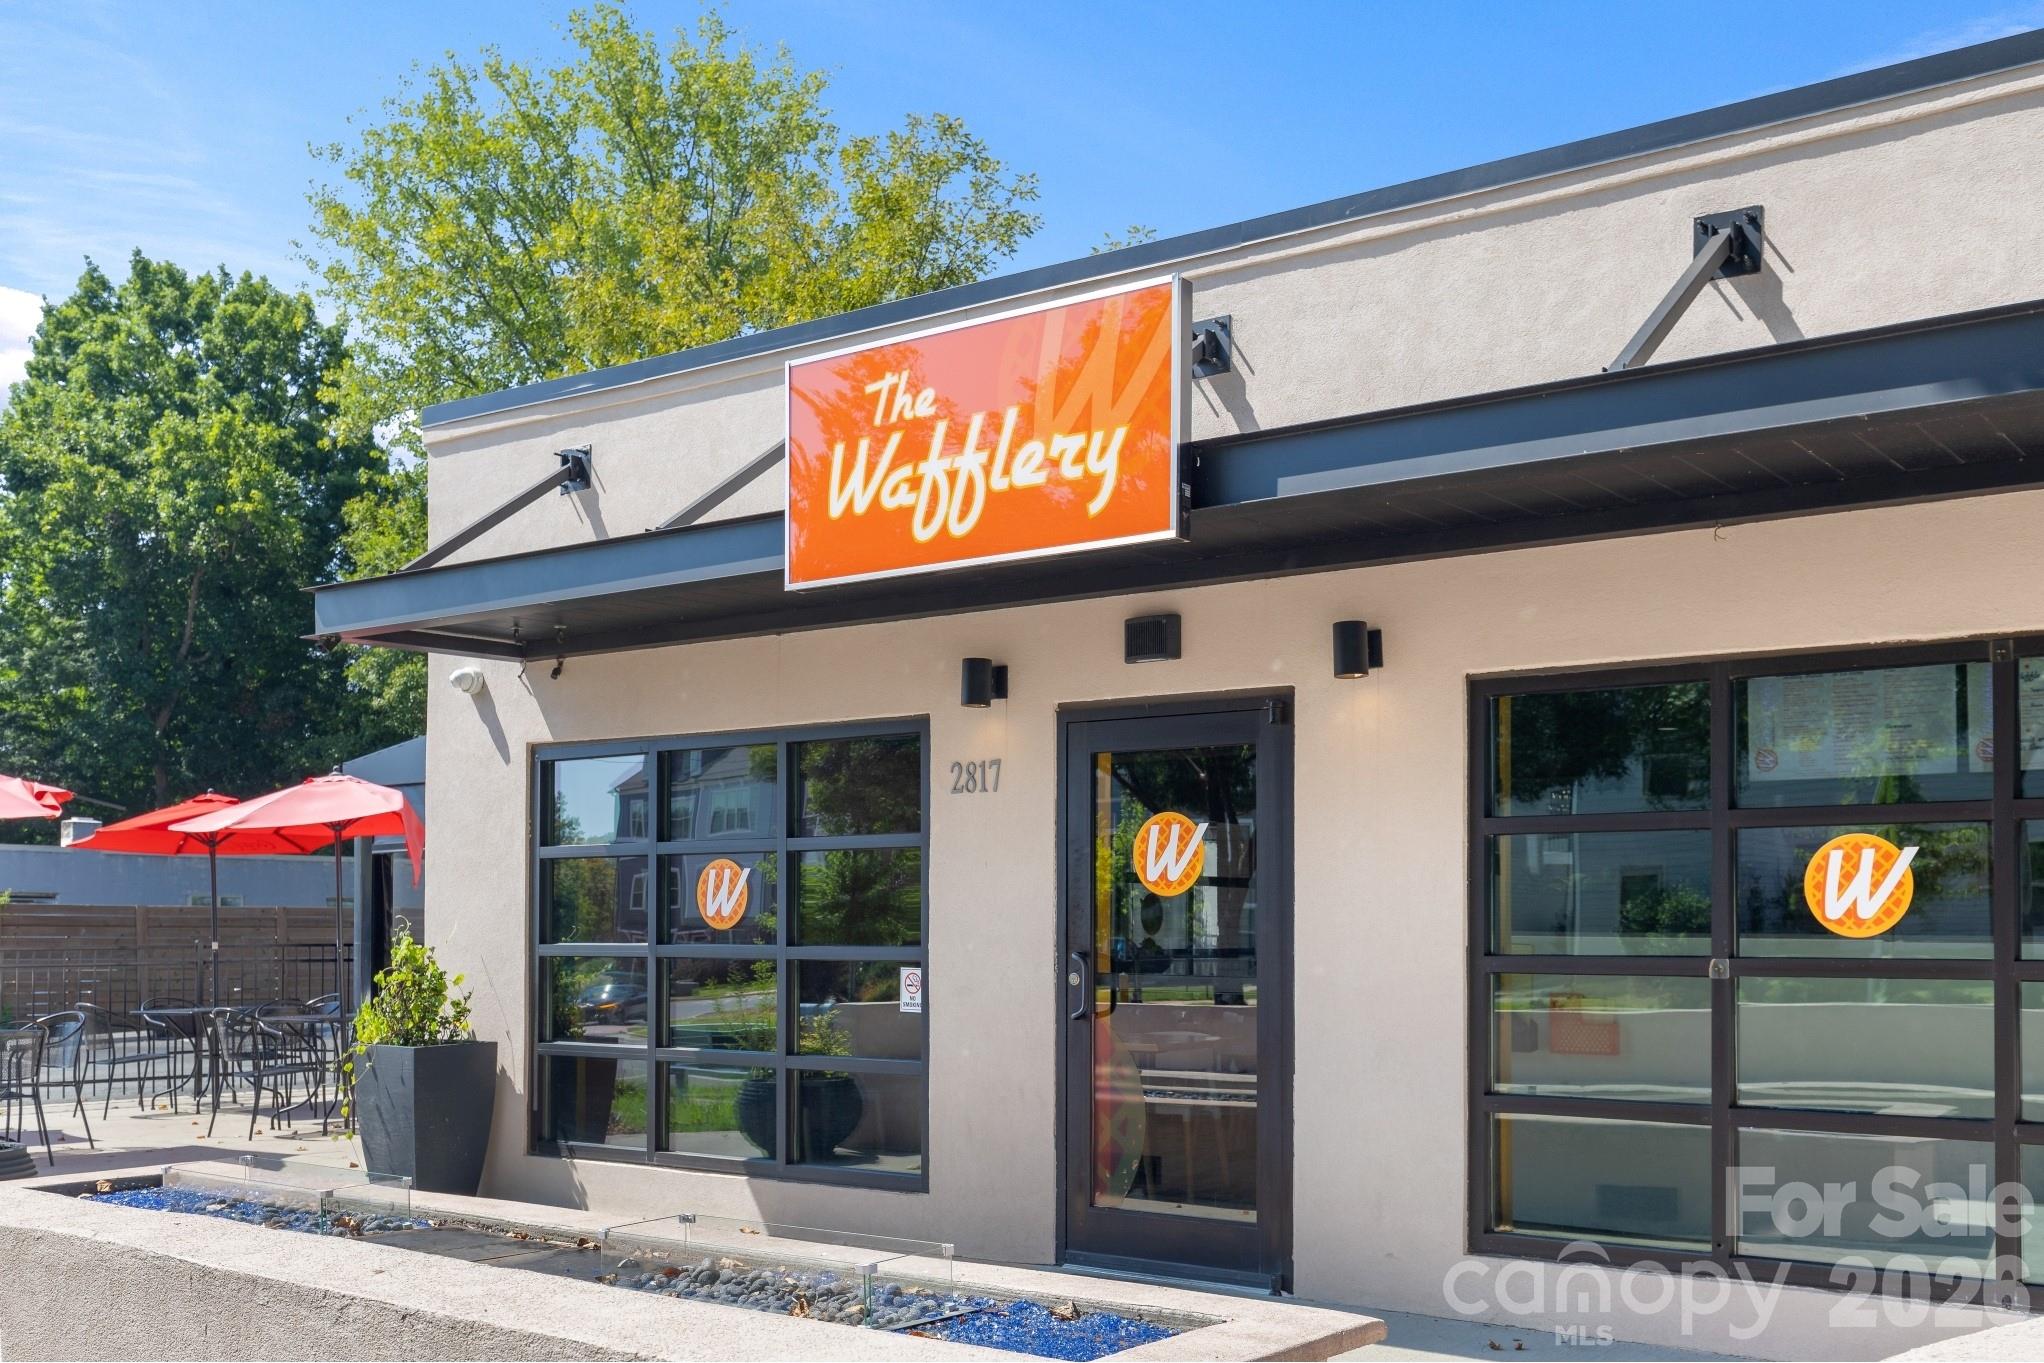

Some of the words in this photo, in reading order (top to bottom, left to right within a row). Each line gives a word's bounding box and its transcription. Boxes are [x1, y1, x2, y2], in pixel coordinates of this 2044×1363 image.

[865, 368, 937, 427] The
[828, 405, 1129, 544] Wafflery
[950, 758, 1002, 795] 2817
[1146, 822, 1209, 882] W
[706, 867, 751, 917] W
[1824, 846, 1920, 920] W
